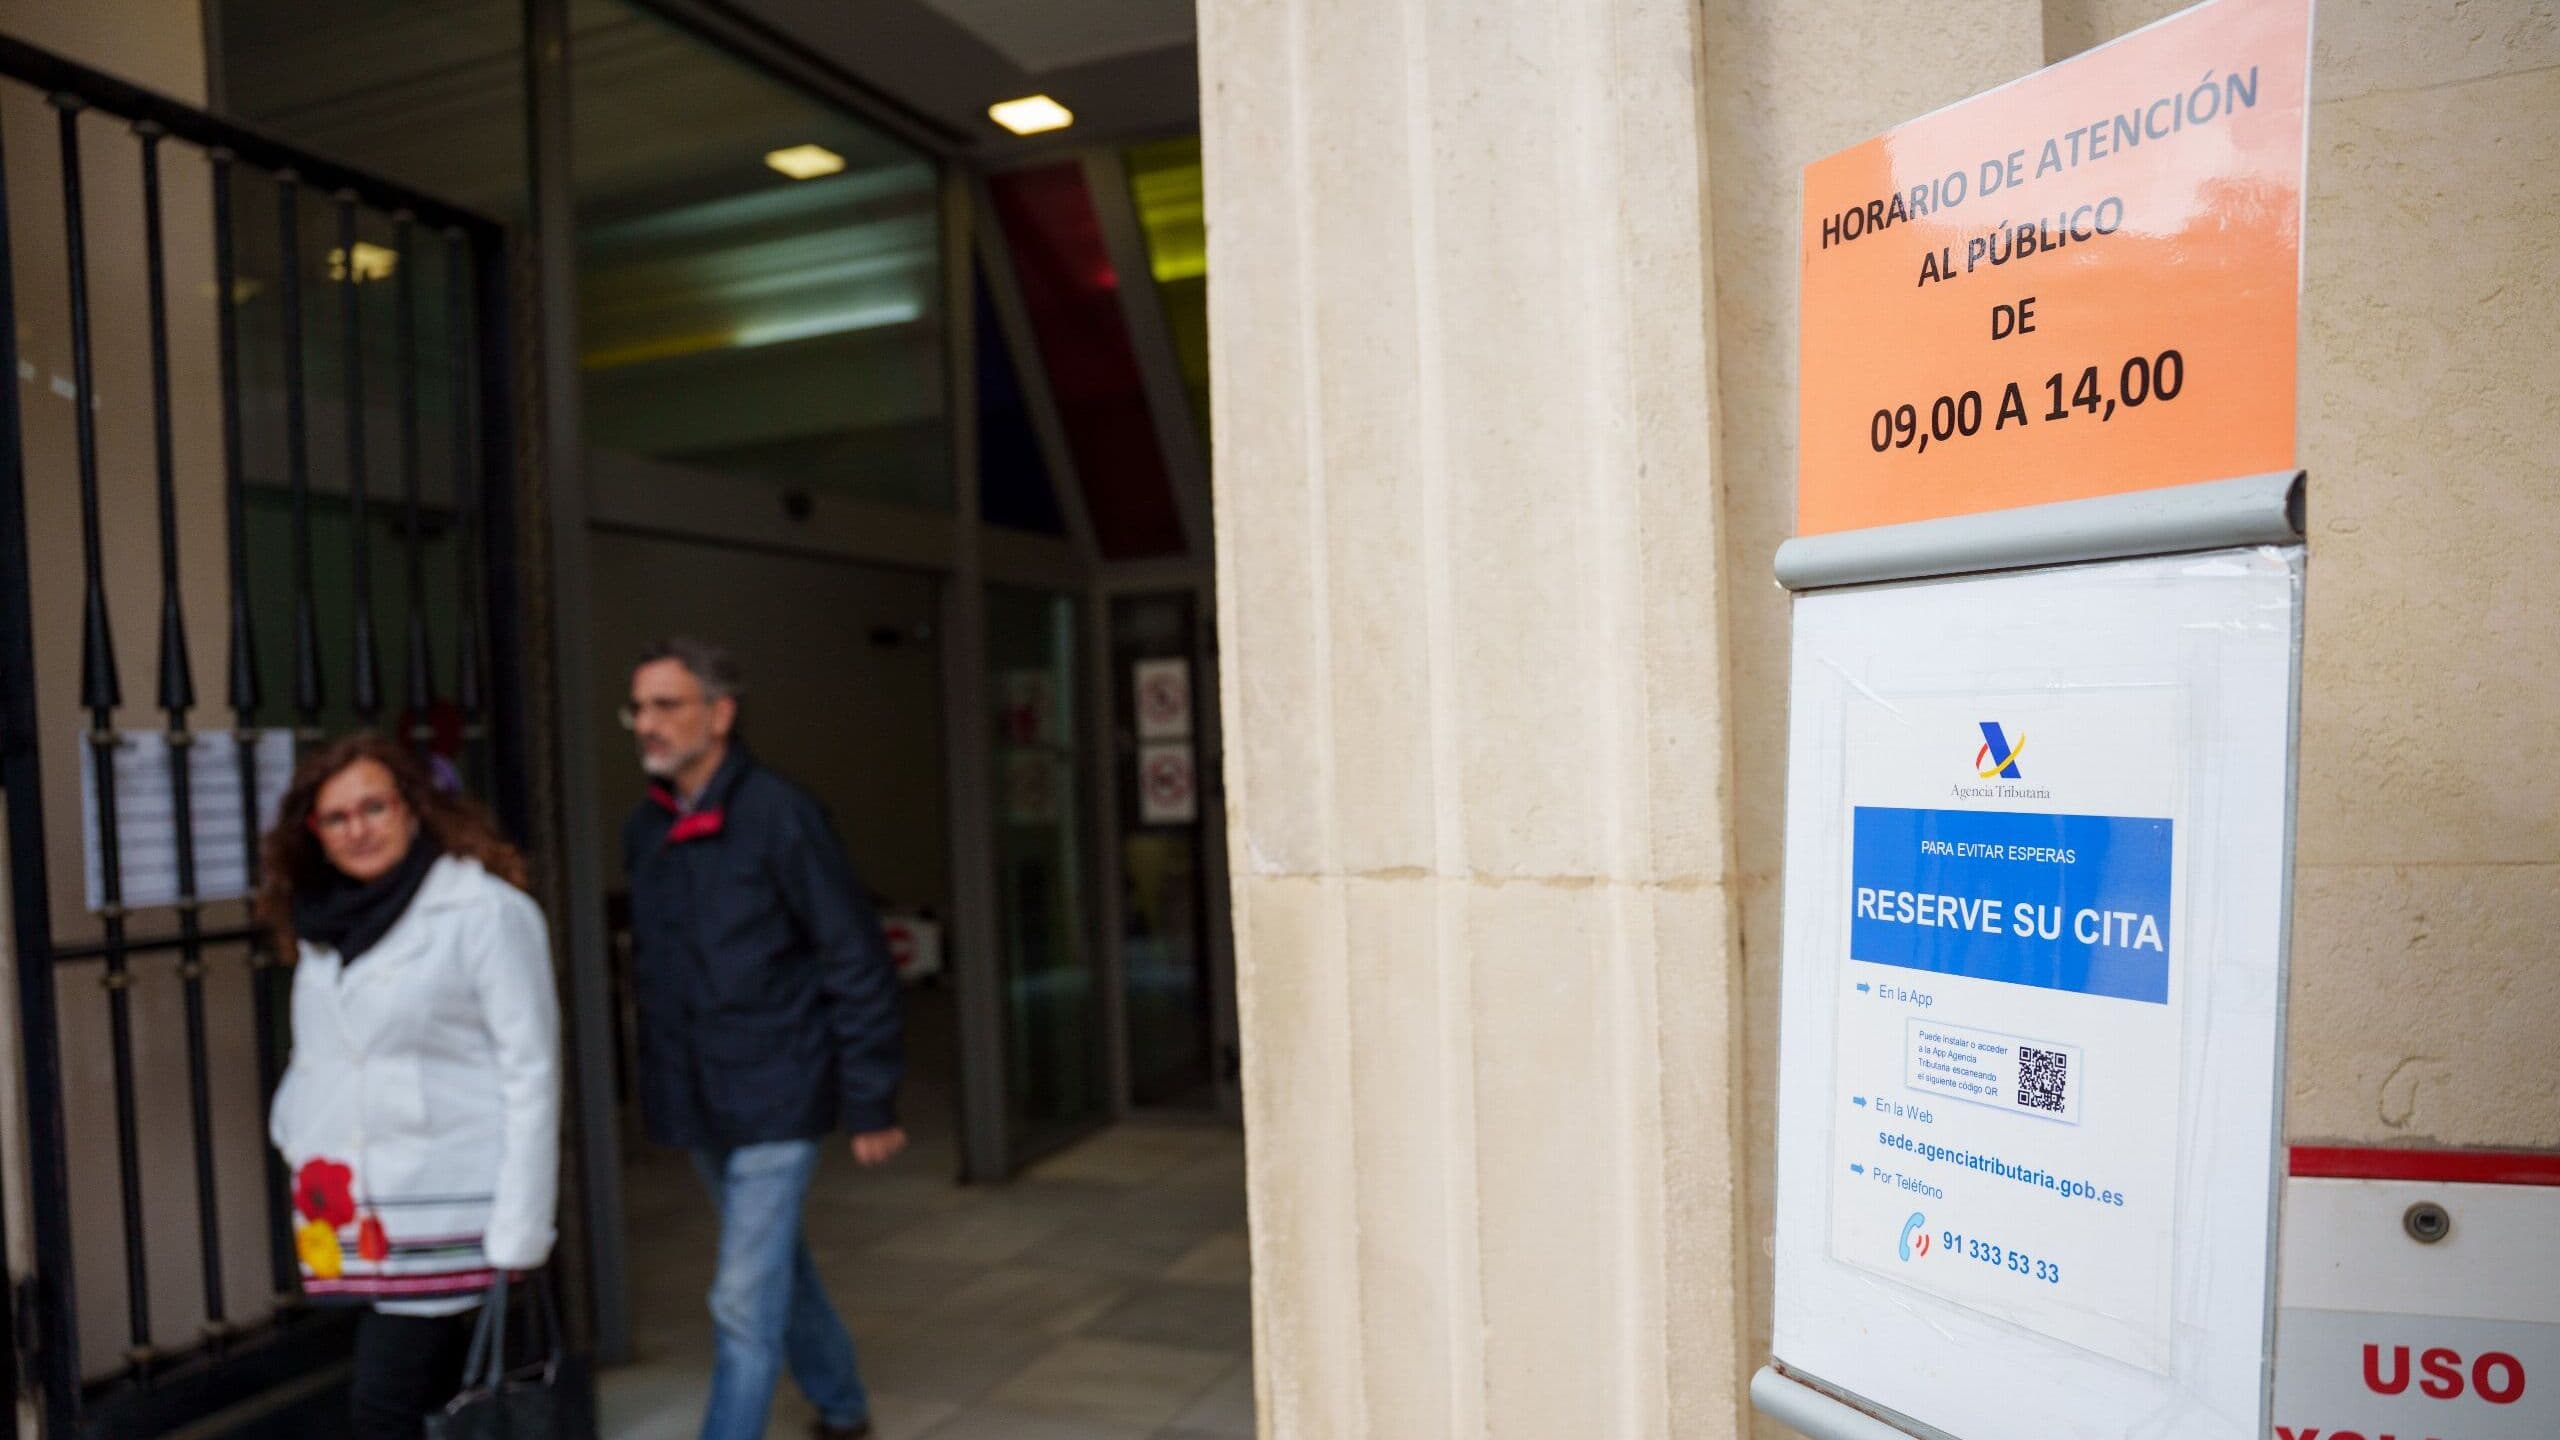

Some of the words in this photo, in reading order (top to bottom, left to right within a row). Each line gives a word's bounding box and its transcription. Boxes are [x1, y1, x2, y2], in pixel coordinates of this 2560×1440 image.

[1822, 171, 1967, 249] HORARIO
[1980, 150, 2025, 197] DE
[2035, 66, 2258, 178] ATENCIÓN
[1918, 247, 1957, 287] AL
[1967, 197, 2124, 273] PÚBLICO
[1991, 297, 2037, 341] DE
[1870, 390, 1982, 454] 09,00
[1995, 382, 2028, 430] A
[2045, 349, 2185, 422] 14,00
[1950, 784, 1993, 800] Agencia
[1995, 785, 2050, 800] Tributaria
[1921, 840, 1954, 856] PARA
[1957, 842, 2004, 860] EVITAR
[2008, 845, 2076, 864] ESPERAS
[1857, 887, 2002, 934] RESERVE
[2012, 903, 2061, 941] SU
[2074, 909, 2164, 953] CITA
[1879, 984, 1894, 1000] En
[1897, 987, 1907, 1002] la
[1910, 990, 1933, 1008] App
[1919, 1030, 1942, 1043] Puede
[1942, 1034, 1969, 1048] instalar
[1977, 1043, 2008, 1055] acceder
[1924, 1045, 1931, 1054] la
[1932, 1047, 1947, 1058] App
[1947, 1051, 1977, 1064] Agencia
[1918, 1057, 1950, 1073] Tributaria
[1952, 1065, 1997, 1082] escaneando
[1926, 1074, 1957, 1088] siguiente
[1958, 1079, 1982, 1094] código
[1985, 1085, 1998, 1097] QR
[1876, 1098, 1891, 1113] En
[1893, 1101, 1904, 1116] la
[1906, 1105, 1933, 1124] Web
[1873, 1167, 1892, 1184] Por
[1895, 1173, 1943, 1200] Teléfono
[1879, 1131, 2124, 1206] sede.agenciatributaria.gob.es
[1943, 1231, 1962, 1254] 91
[1969, 1239, 2001, 1266] 333
[2008, 1251, 2029, 1275] 53
[2036, 1260, 2059, 1284] 33
[2363, 1343, 2526, 1405] USO
